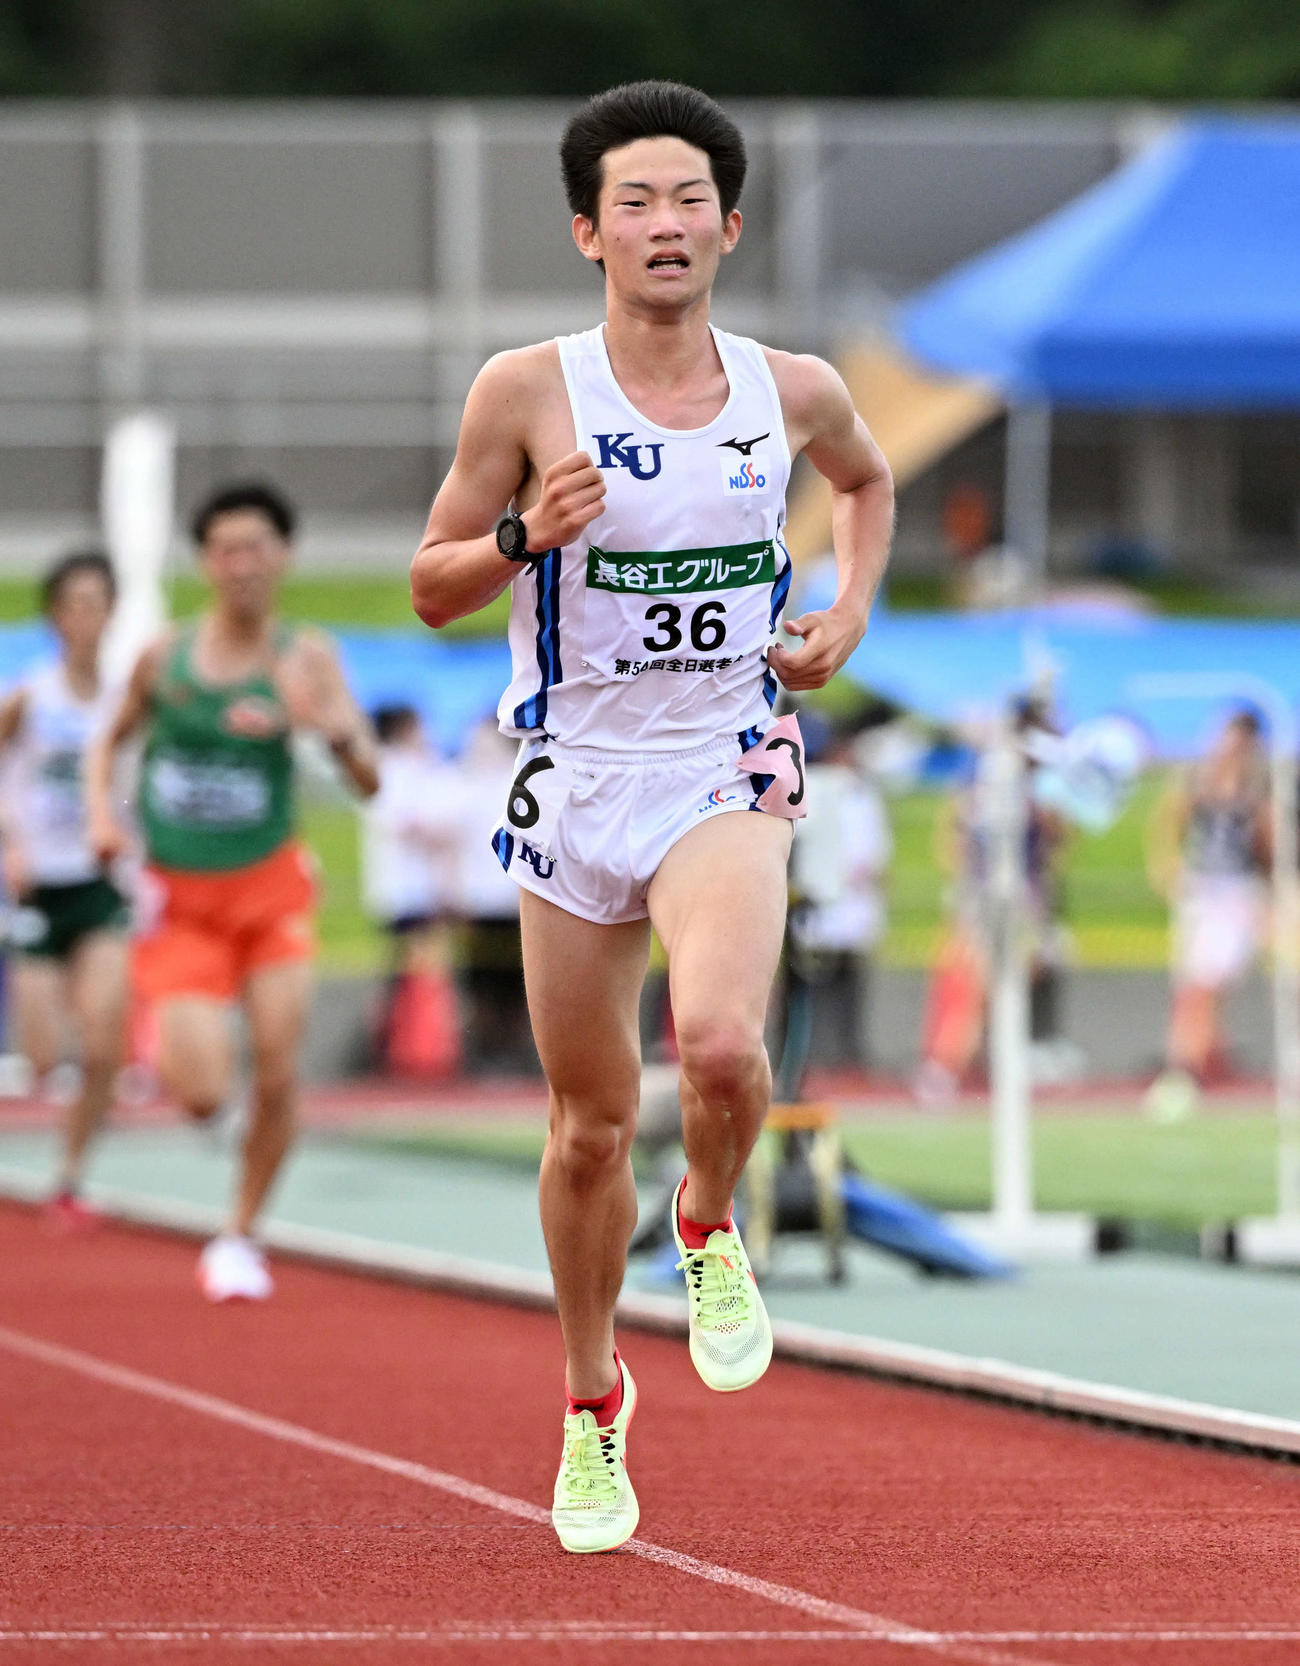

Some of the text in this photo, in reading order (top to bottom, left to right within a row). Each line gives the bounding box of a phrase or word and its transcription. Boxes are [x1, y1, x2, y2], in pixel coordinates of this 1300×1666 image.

[592, 432, 664, 480] KU
[729, 462, 766, 489] NISSO
[594, 549, 771, 589] 長谷工グループ
[643, 601, 727, 652] 36
[507, 755, 555, 829] 6
